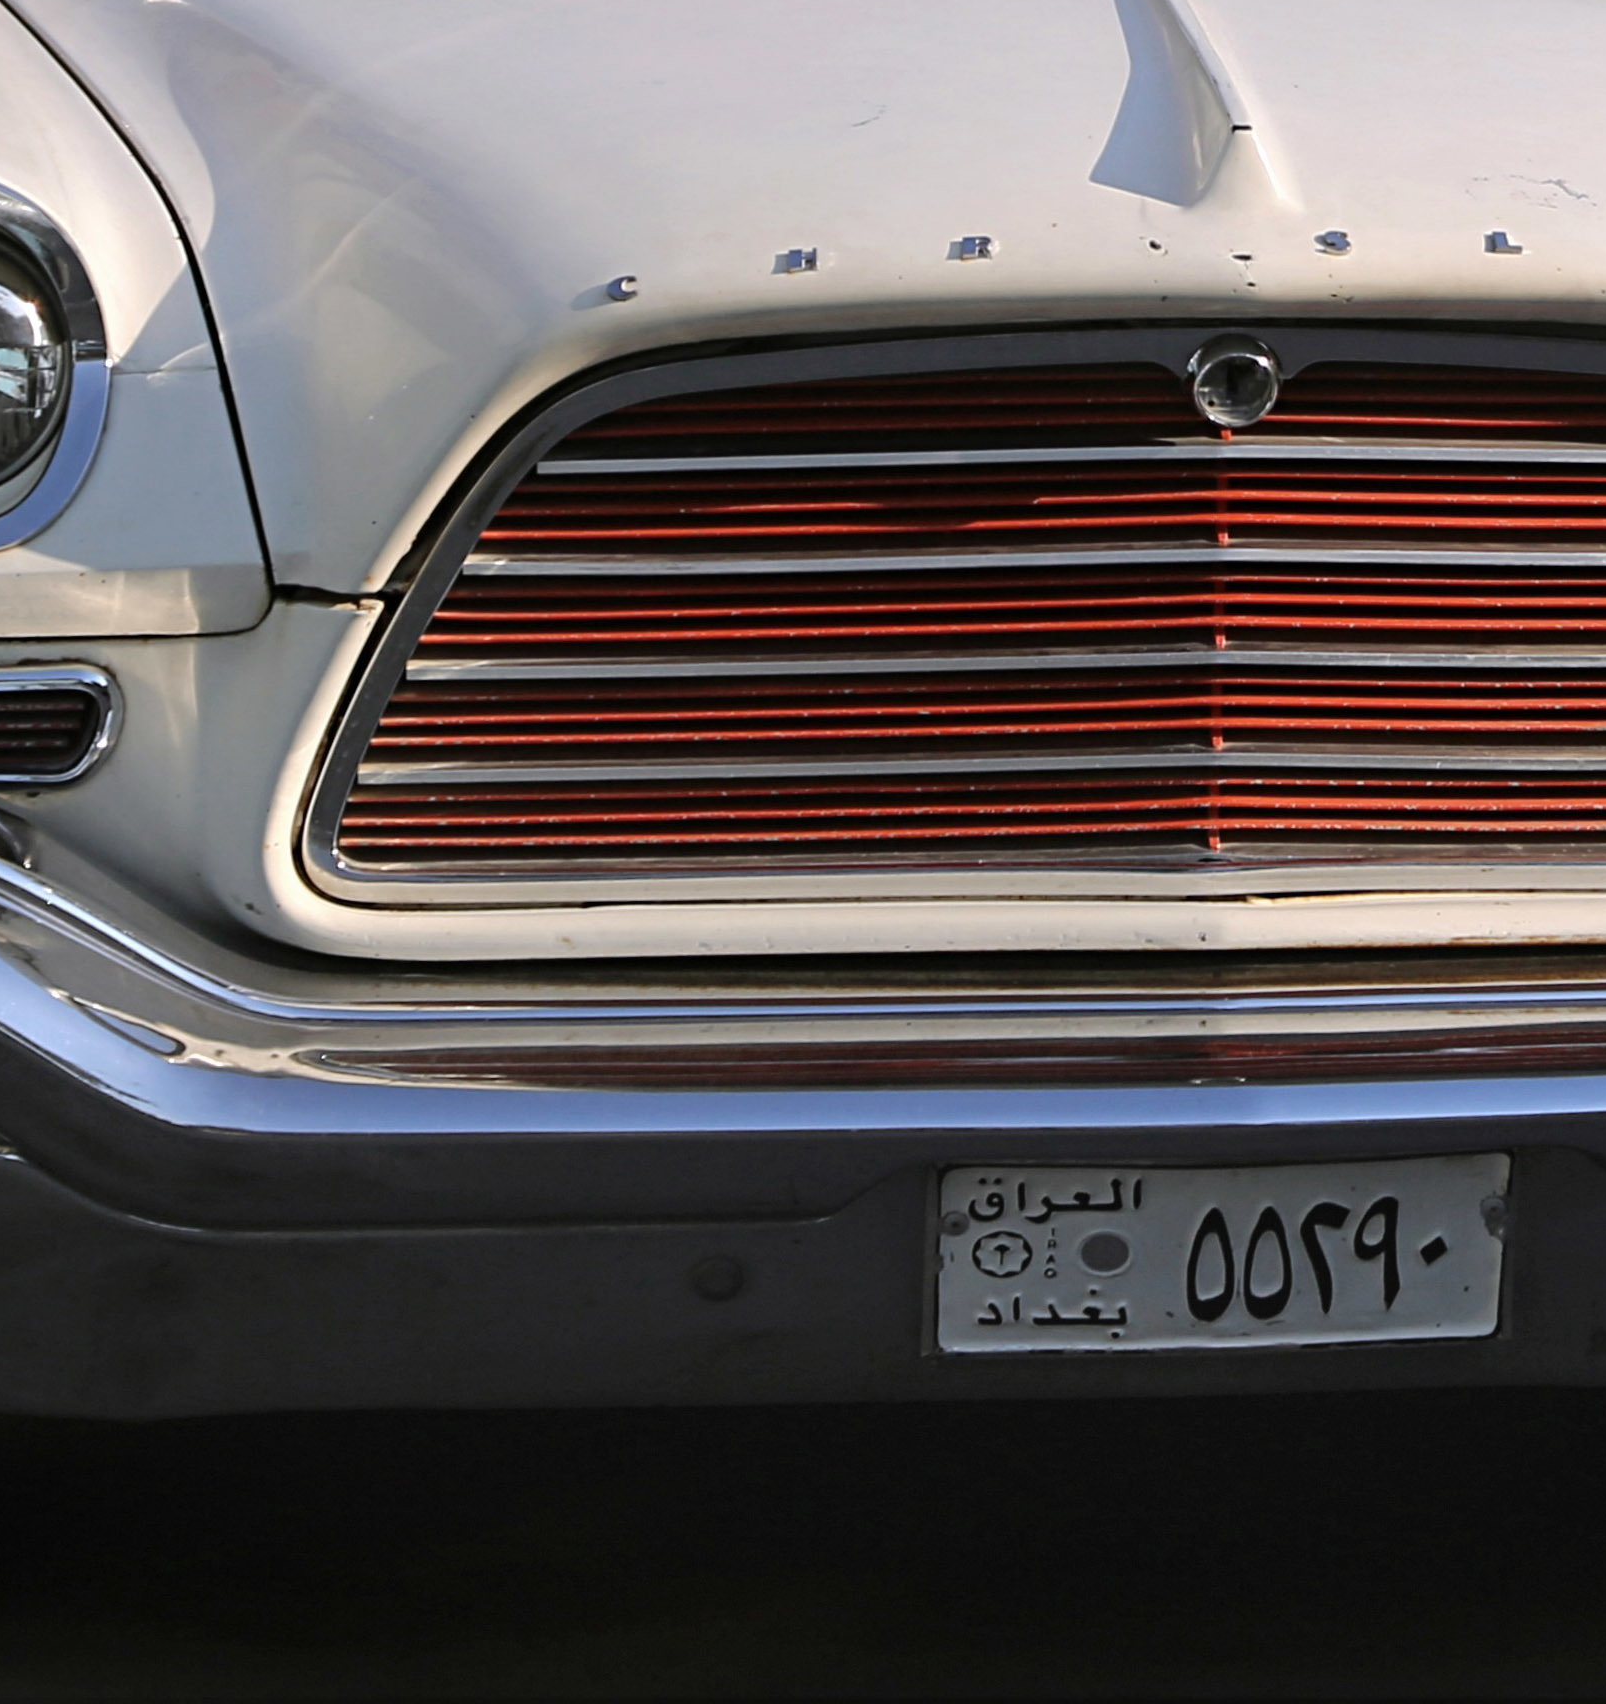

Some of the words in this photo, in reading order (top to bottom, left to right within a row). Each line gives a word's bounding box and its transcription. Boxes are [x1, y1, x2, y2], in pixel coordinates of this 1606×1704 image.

[968, 1177, 1142, 1224] العراق
[1186, 1195, 1449, 1323] ٥٥٢٩٠
[977, 1288, 1127, 1339] بغداد
